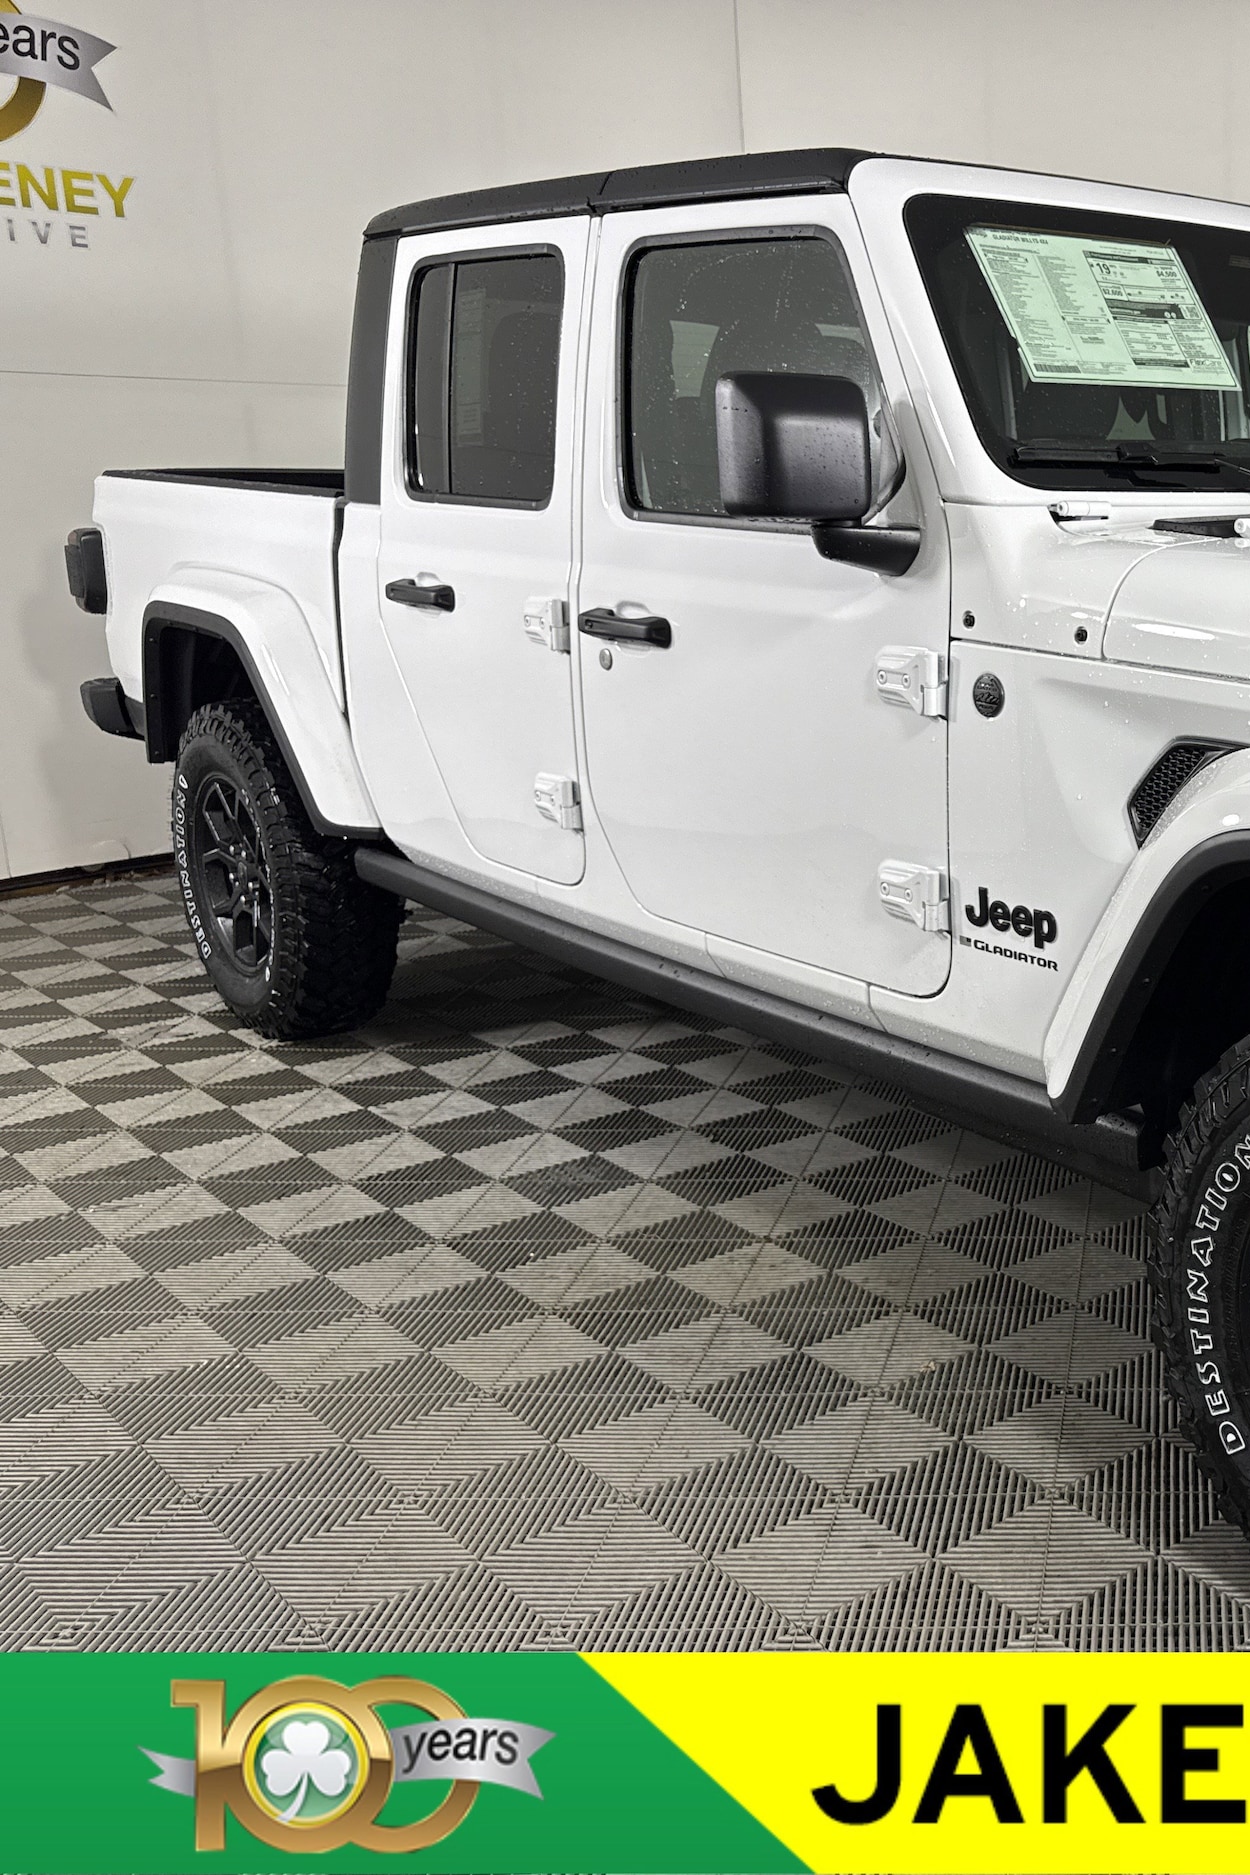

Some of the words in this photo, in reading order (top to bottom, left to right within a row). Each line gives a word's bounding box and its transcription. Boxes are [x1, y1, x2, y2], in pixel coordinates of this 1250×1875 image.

[1096, 262, 1111, 275] 19
[175, 790, 212, 960] DESTINATION
[965, 886, 1058, 949] Jeep
[973, 939, 1060, 973] GLADIATOR
